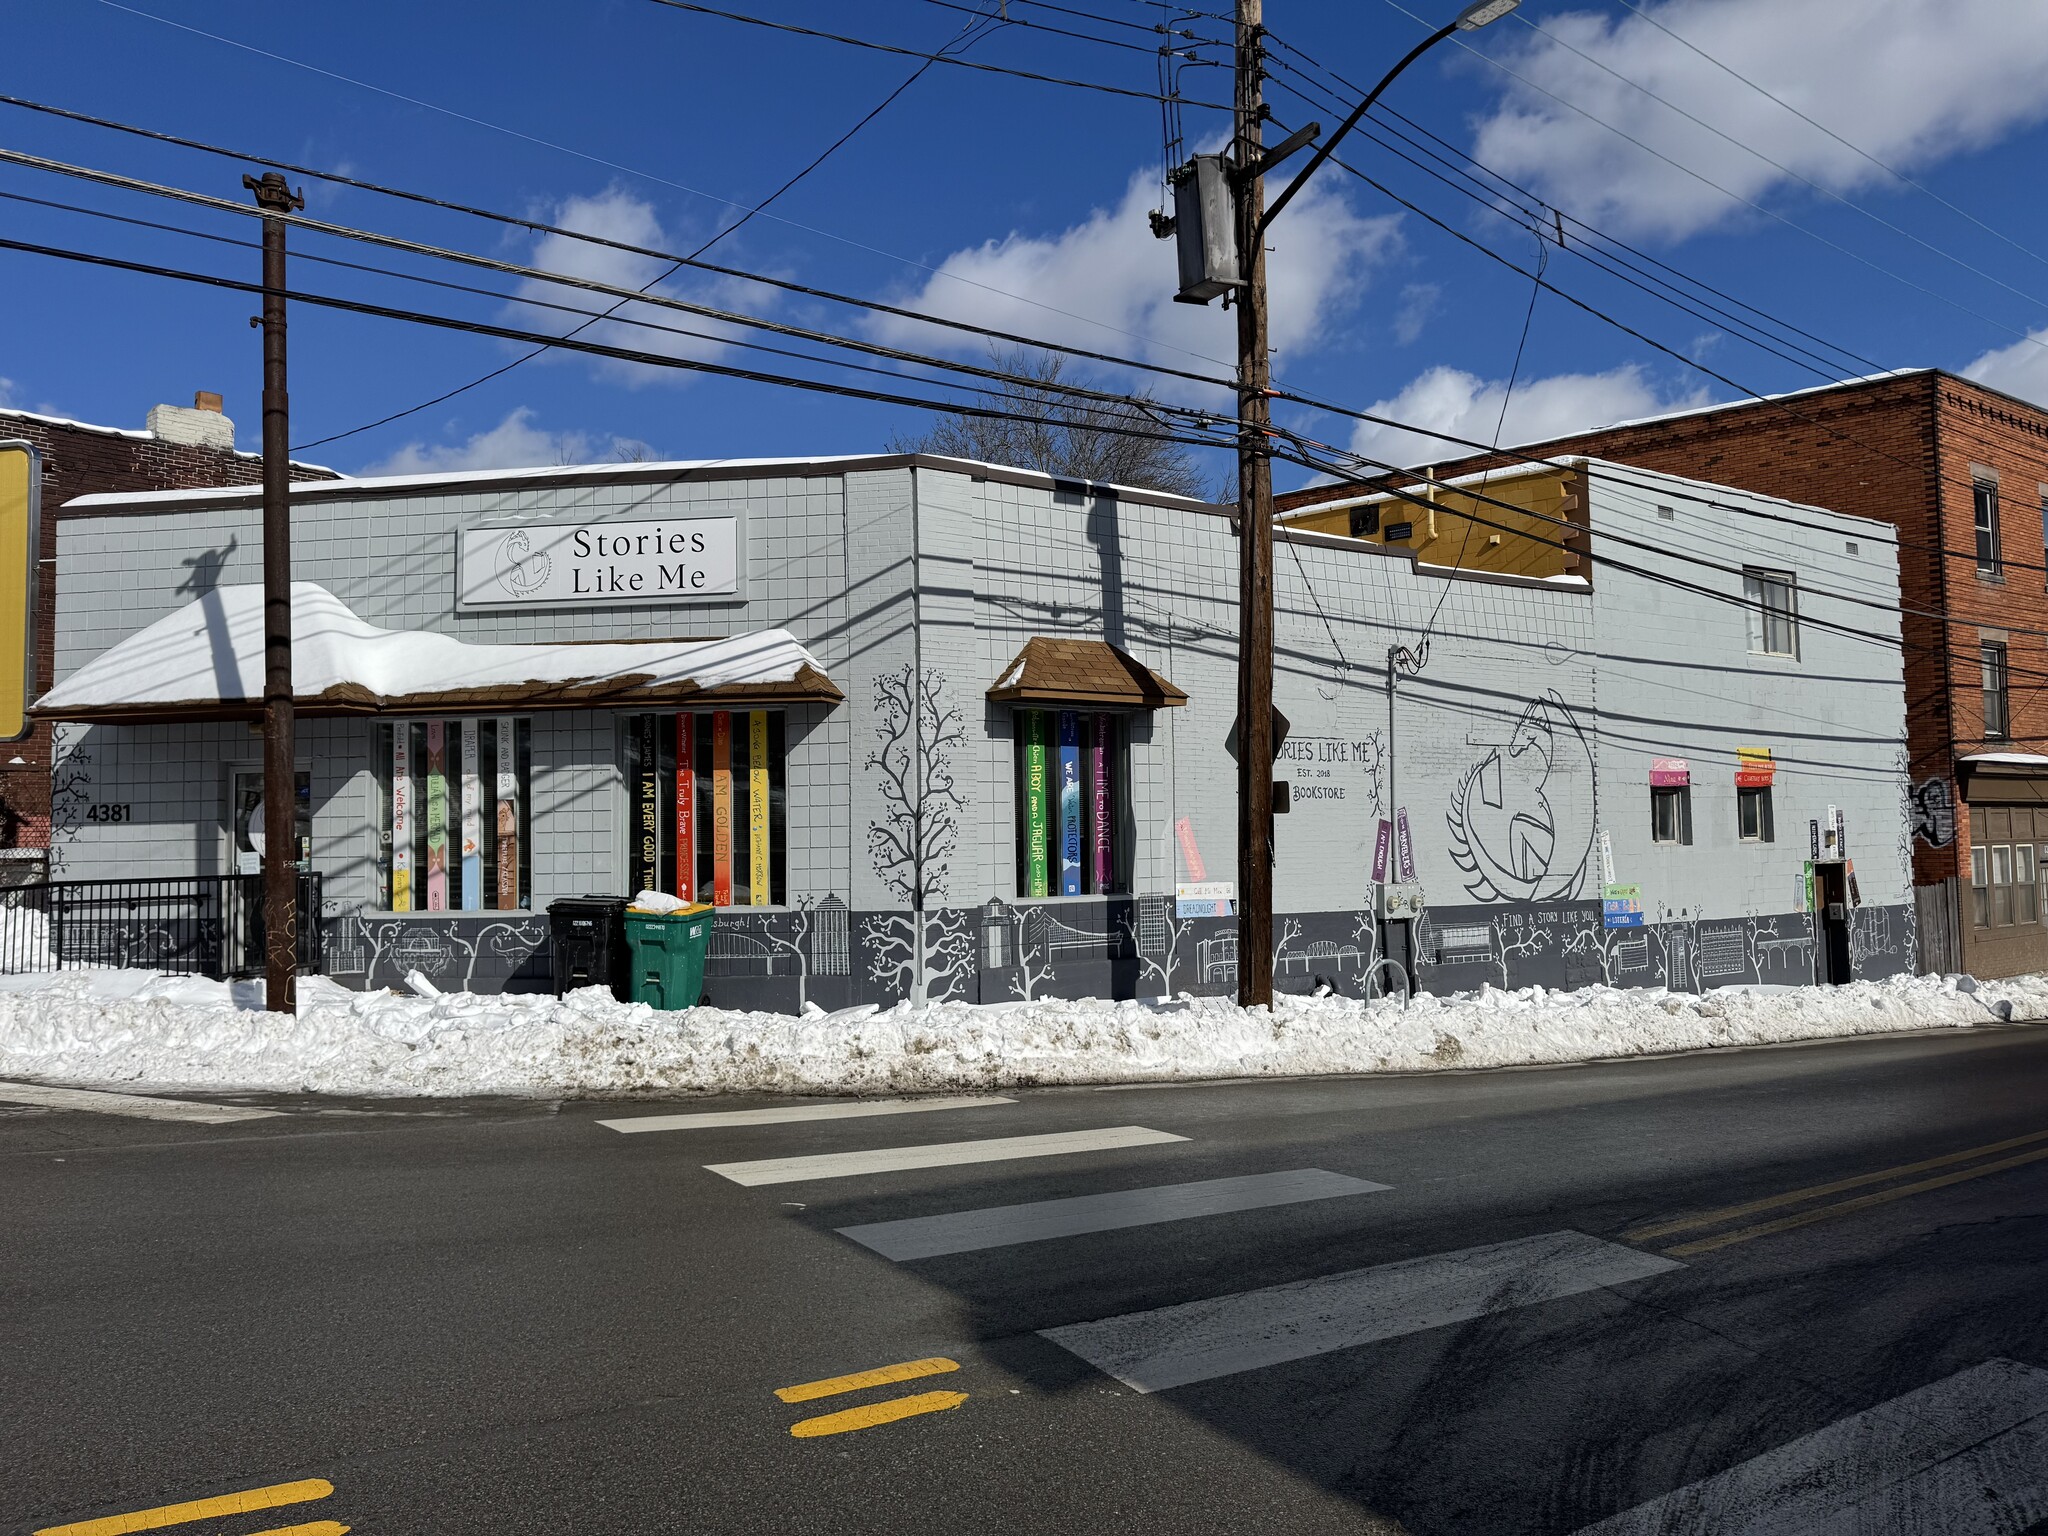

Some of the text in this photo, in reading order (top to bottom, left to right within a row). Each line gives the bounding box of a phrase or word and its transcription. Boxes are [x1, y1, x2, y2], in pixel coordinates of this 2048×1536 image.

[573, 528, 705, 557] Stories
[572, 564, 706, 594] Like Me
[464, 730, 476, 760] DRAPER
[753, 727, 762, 750] SONG
[501, 721, 510, 788] SKUNK AND BADGER
[643, 744, 652, 767] JAMES
[1032, 745, 1040, 764] Chien
[1319, 742, 1348, 762] LIKE
[679, 759, 689, 777] The
[752, 754, 762, 784] BELOW
[1031, 764, 1042, 772] A
[1065, 761, 1073, 775] WE
[1297, 768, 1330, 778] EST. 2018
[395, 752, 406, 831] All Are Welcome
[642, 781, 655, 799] AM
[677, 779, 690, 806] Truly
[716, 774, 728, 796] AM
[1031, 773, 1042, 793] BOY
[1096, 766, 1110, 800] TIME
[1293, 785, 1345, 801] BOOKSTORE
[465, 794, 472, 805] my
[752, 789, 763, 822] WATER
[1098, 799, 1104, 811] TO
[86, 804, 131, 822] 4381
[642, 802, 655, 833] EVERY
[679, 810, 690, 835] Brave
[429, 813, 440, 844] MERMAID
[716, 806, 728, 862] GOLDEN
[1067, 816, 1078, 864] PROTECTORS
[1096, 811, 1110, 854] DANCE
[1380, 834, 1387, 844] AM
[643, 836, 655, 863] GOOD
[1031, 821, 1044, 862] JAGUAR
[1377, 845, 1385, 870] ENOUGH
[643, 867, 654, 891] THIN
[711, 916, 750, 931] sburgh!
[1503, 910, 1597, 927] FIND A STORY LIKE YOU.
